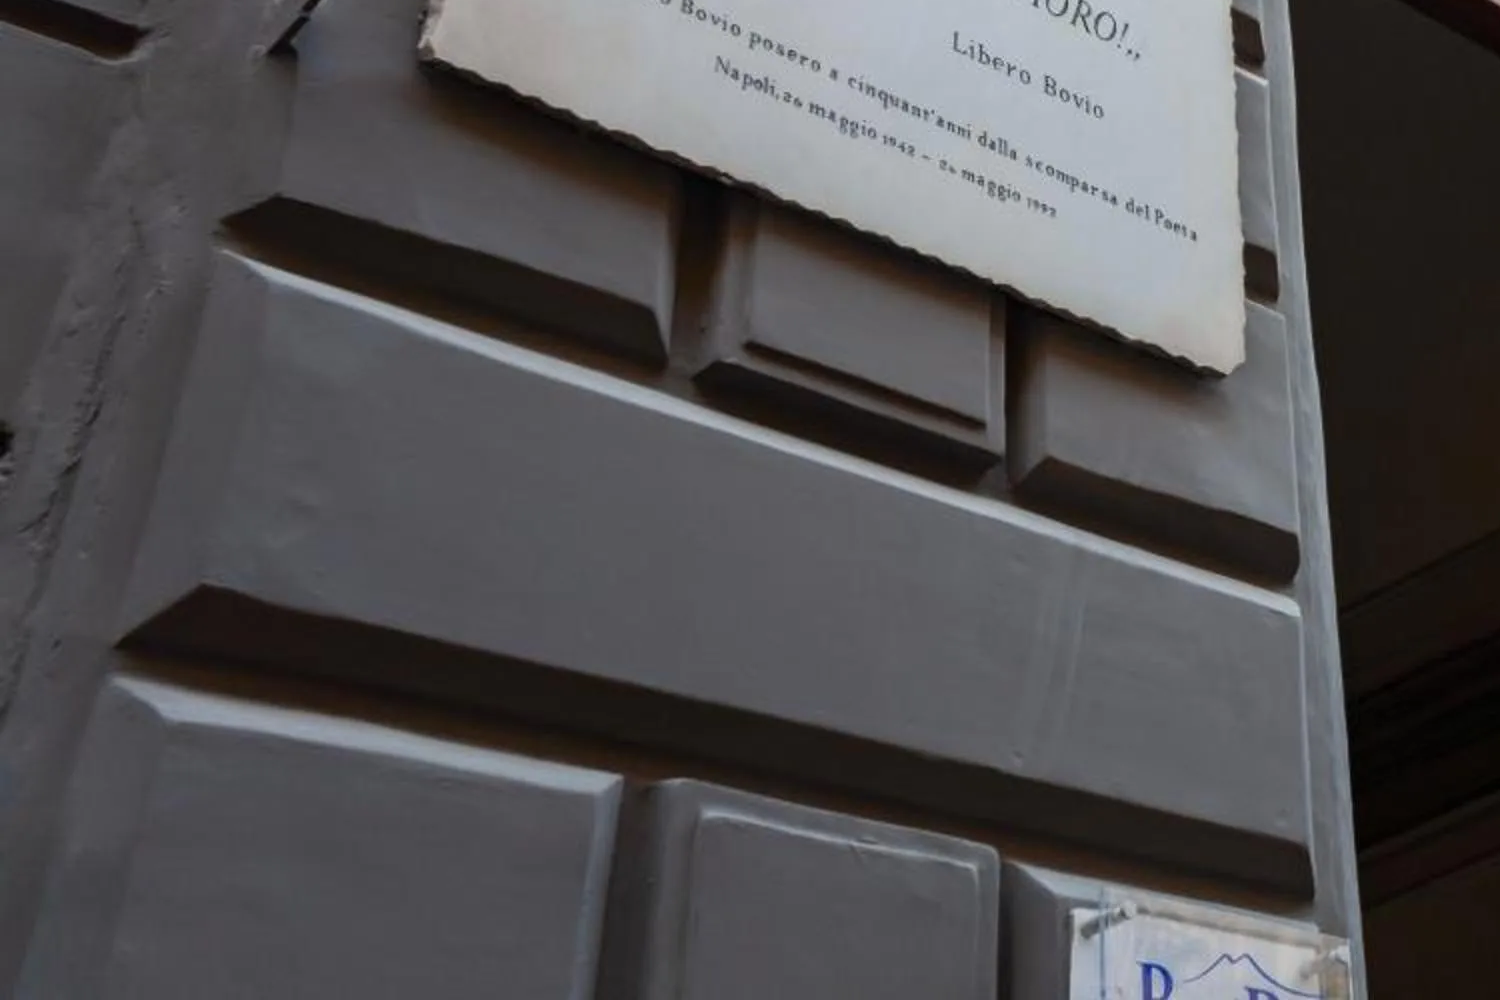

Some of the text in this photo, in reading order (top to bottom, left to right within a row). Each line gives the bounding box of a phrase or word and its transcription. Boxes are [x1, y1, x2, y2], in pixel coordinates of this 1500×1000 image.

[714, 55, 781, 102] Napoli,
[808, 100, 879, 142] maggio
[960, 166, 1023, 203] maggio
[749, 30, 822, 74] posero
[829, 67, 839, 82] a
[977, 130, 1018, 162] dalla
[1025, 155, 1118, 206] scomparsa
[1125, 197, 1151, 222] del
[1154, 207, 1198, 242] Poeta
[953, 30, 1106, 120] Libero Bovio
